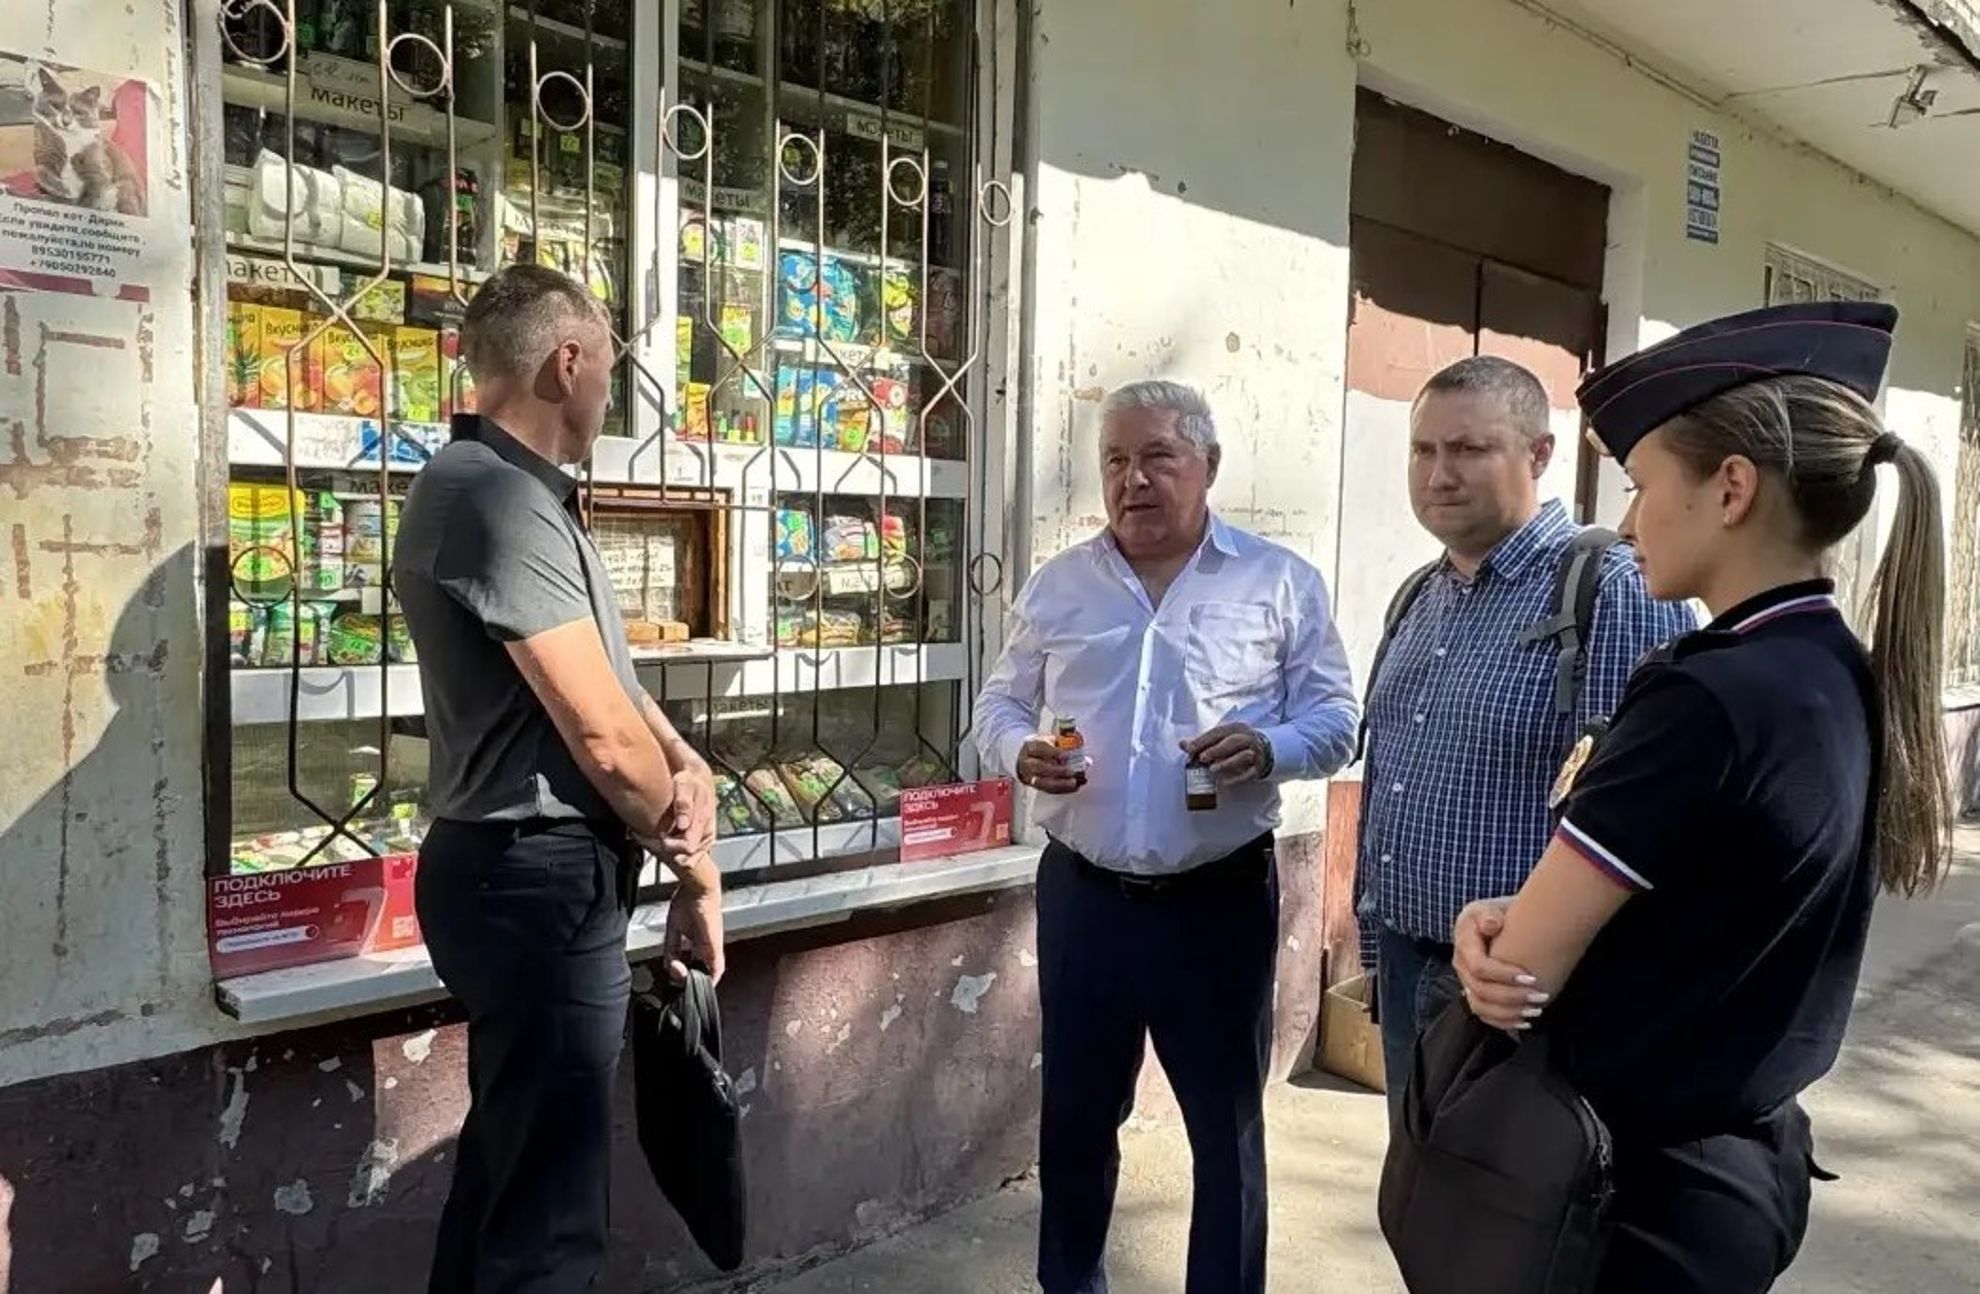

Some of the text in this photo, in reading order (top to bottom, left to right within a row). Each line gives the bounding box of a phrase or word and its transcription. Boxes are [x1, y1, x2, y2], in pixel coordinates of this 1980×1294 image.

[684, 184, 750, 207] Маеты
[14, 202, 59, 217] Пропал
[214, 865, 352, 893] ПОДКЛЮЧИТЕ
[214, 889, 281, 909] ЗДЕСЬ
